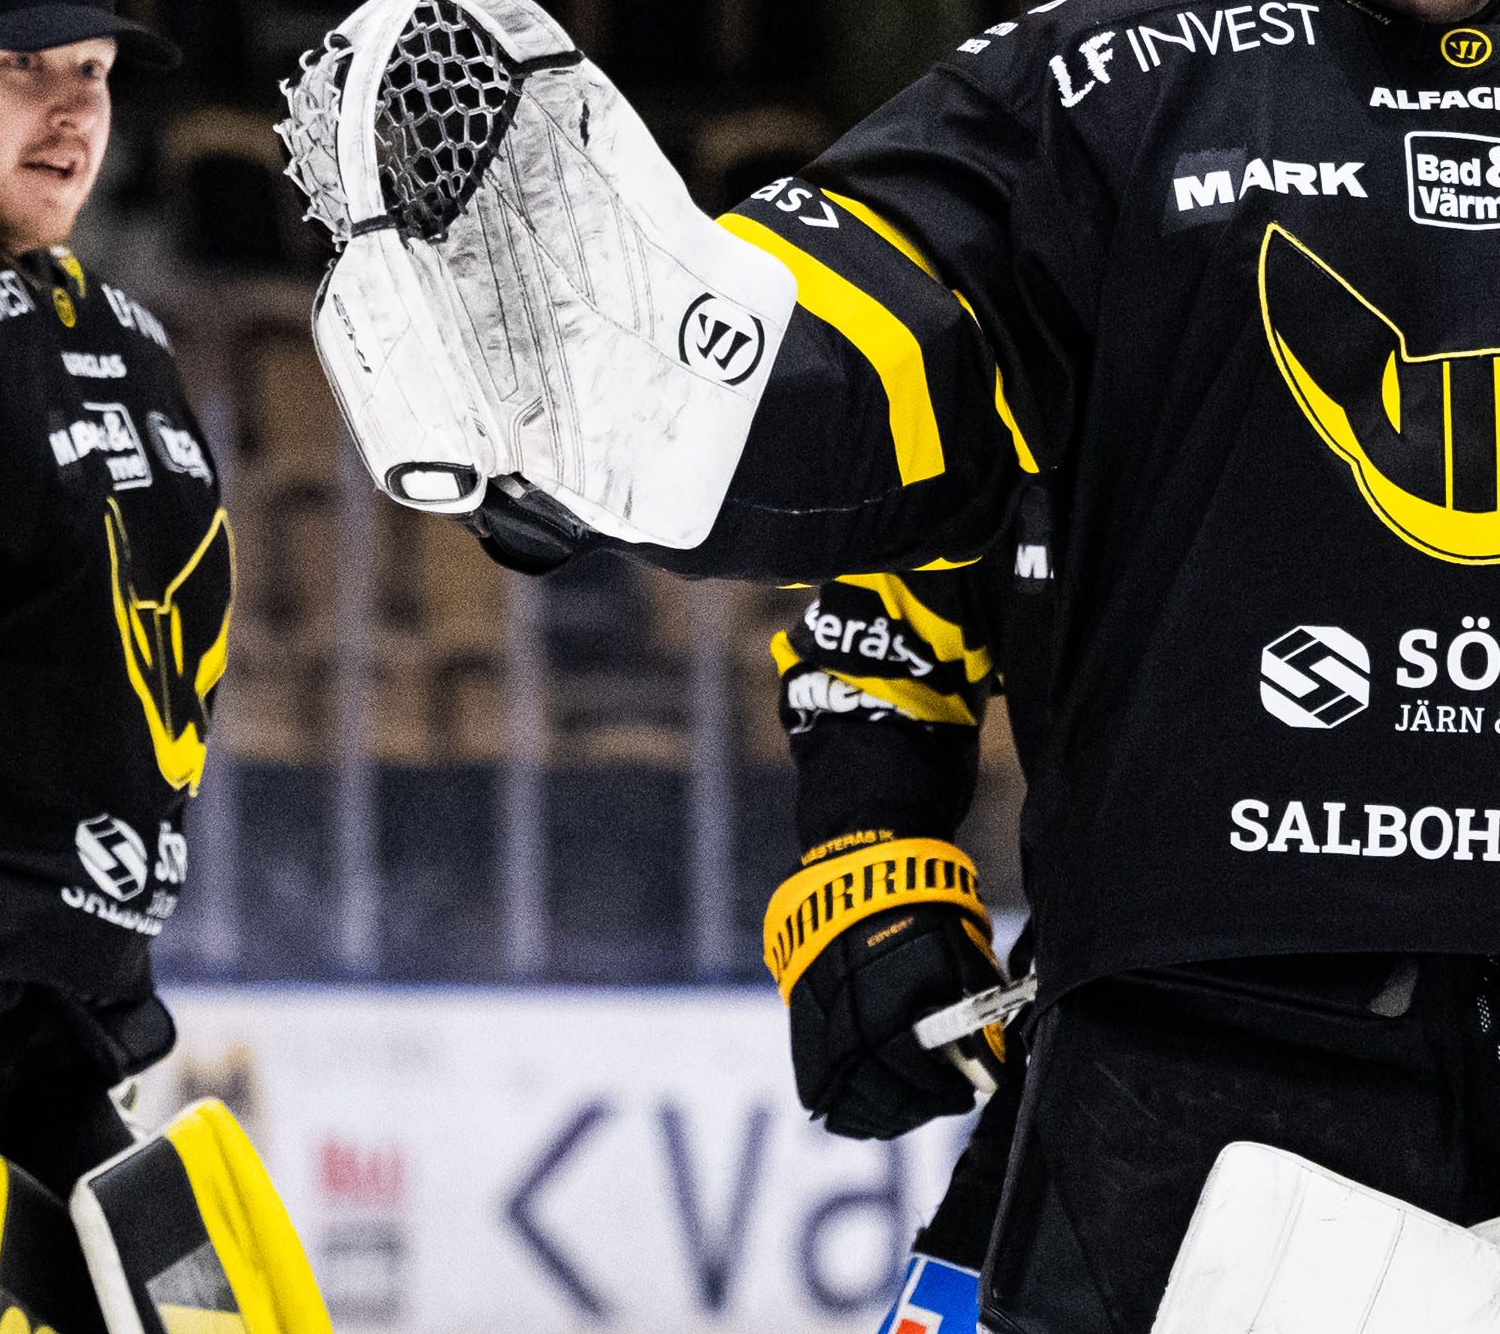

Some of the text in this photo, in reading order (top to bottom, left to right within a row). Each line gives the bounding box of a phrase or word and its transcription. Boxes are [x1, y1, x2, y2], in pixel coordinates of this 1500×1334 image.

[1048, 30, 1117, 108] LF
[1125, 2, 1321, 73] INVEST
[1172, 158, 1369, 212] MARK
[1416, 154, 1481, 186] Bad
[1395, 699, 1484, 735] JÄRN
